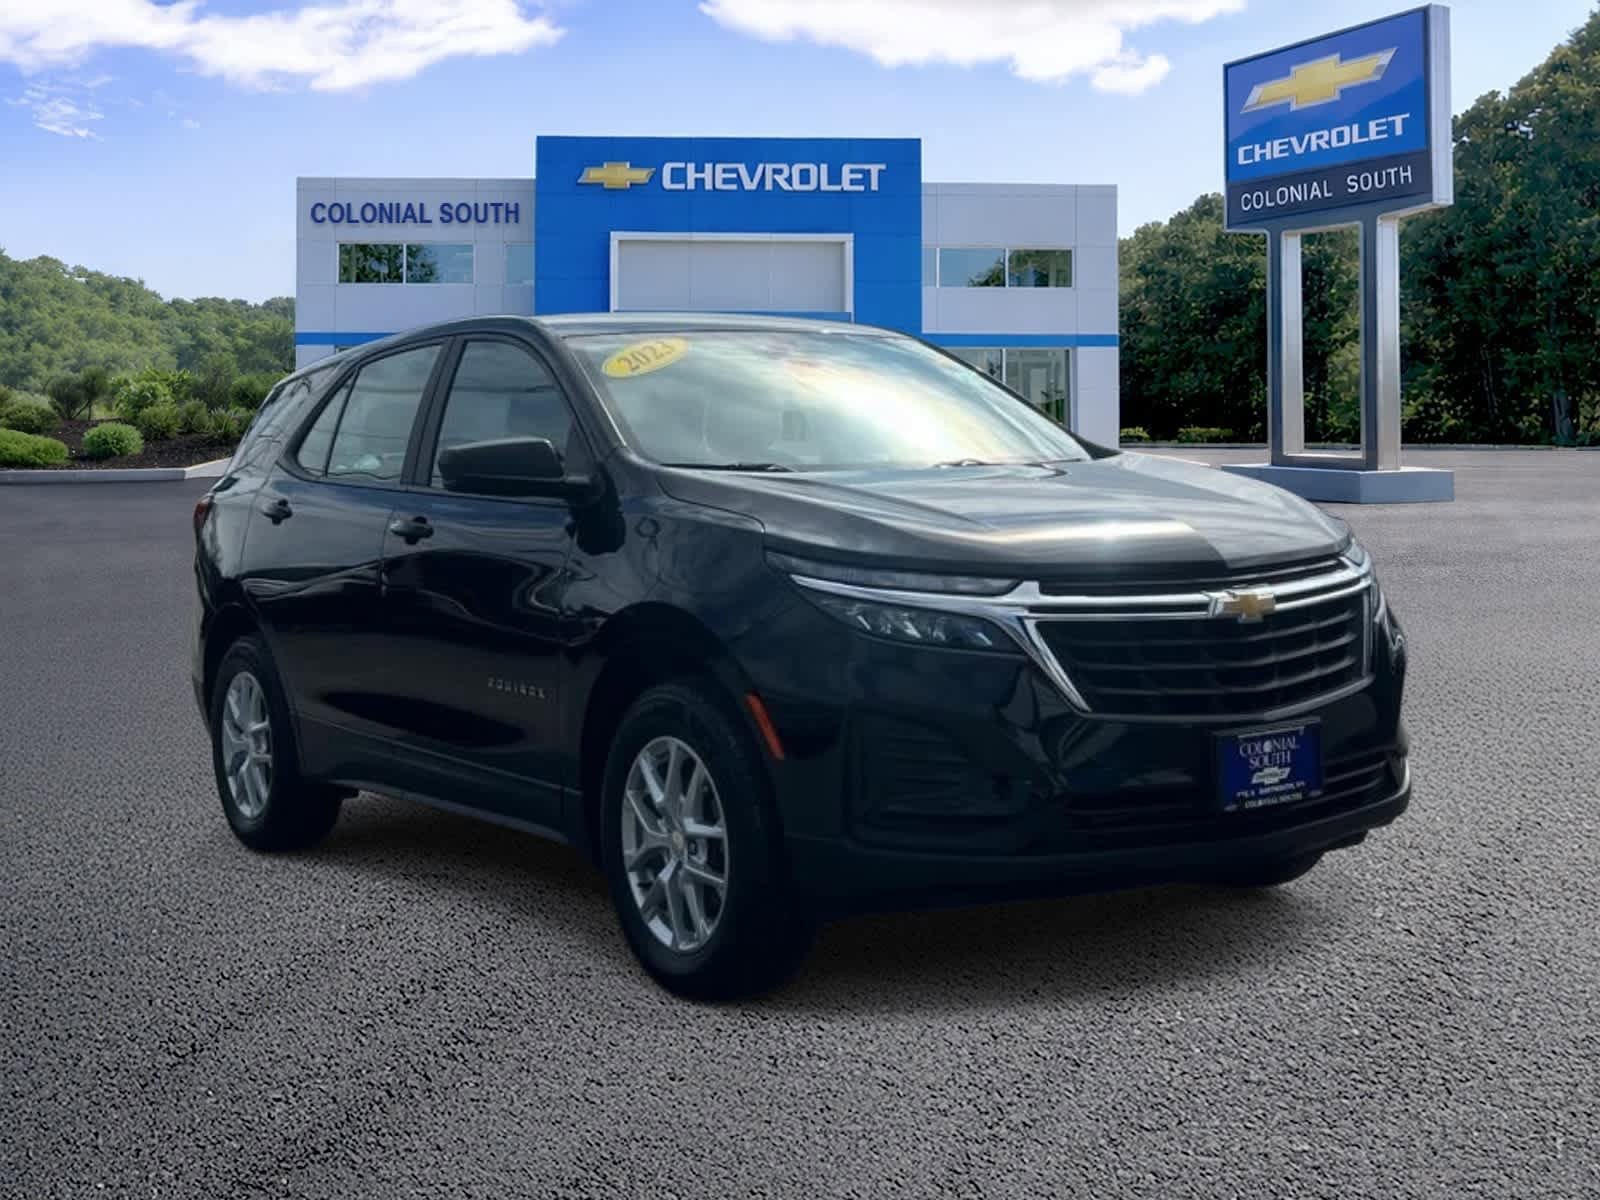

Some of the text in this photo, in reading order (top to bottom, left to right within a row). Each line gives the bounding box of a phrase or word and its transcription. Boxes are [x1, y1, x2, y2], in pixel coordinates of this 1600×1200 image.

[1238, 113, 1410, 165] CHEVROLET
[662, 162, 886, 191] CHEVROLET
[1241, 165, 1413, 212] COLONIAL SOUTH
[310, 202, 520, 224] COLONIAL SOUTH
[616, 343, 676, 371] 2023
[1239, 736, 1301, 757] COLONIAL
[1248, 750, 1291, 769] SOUTH
